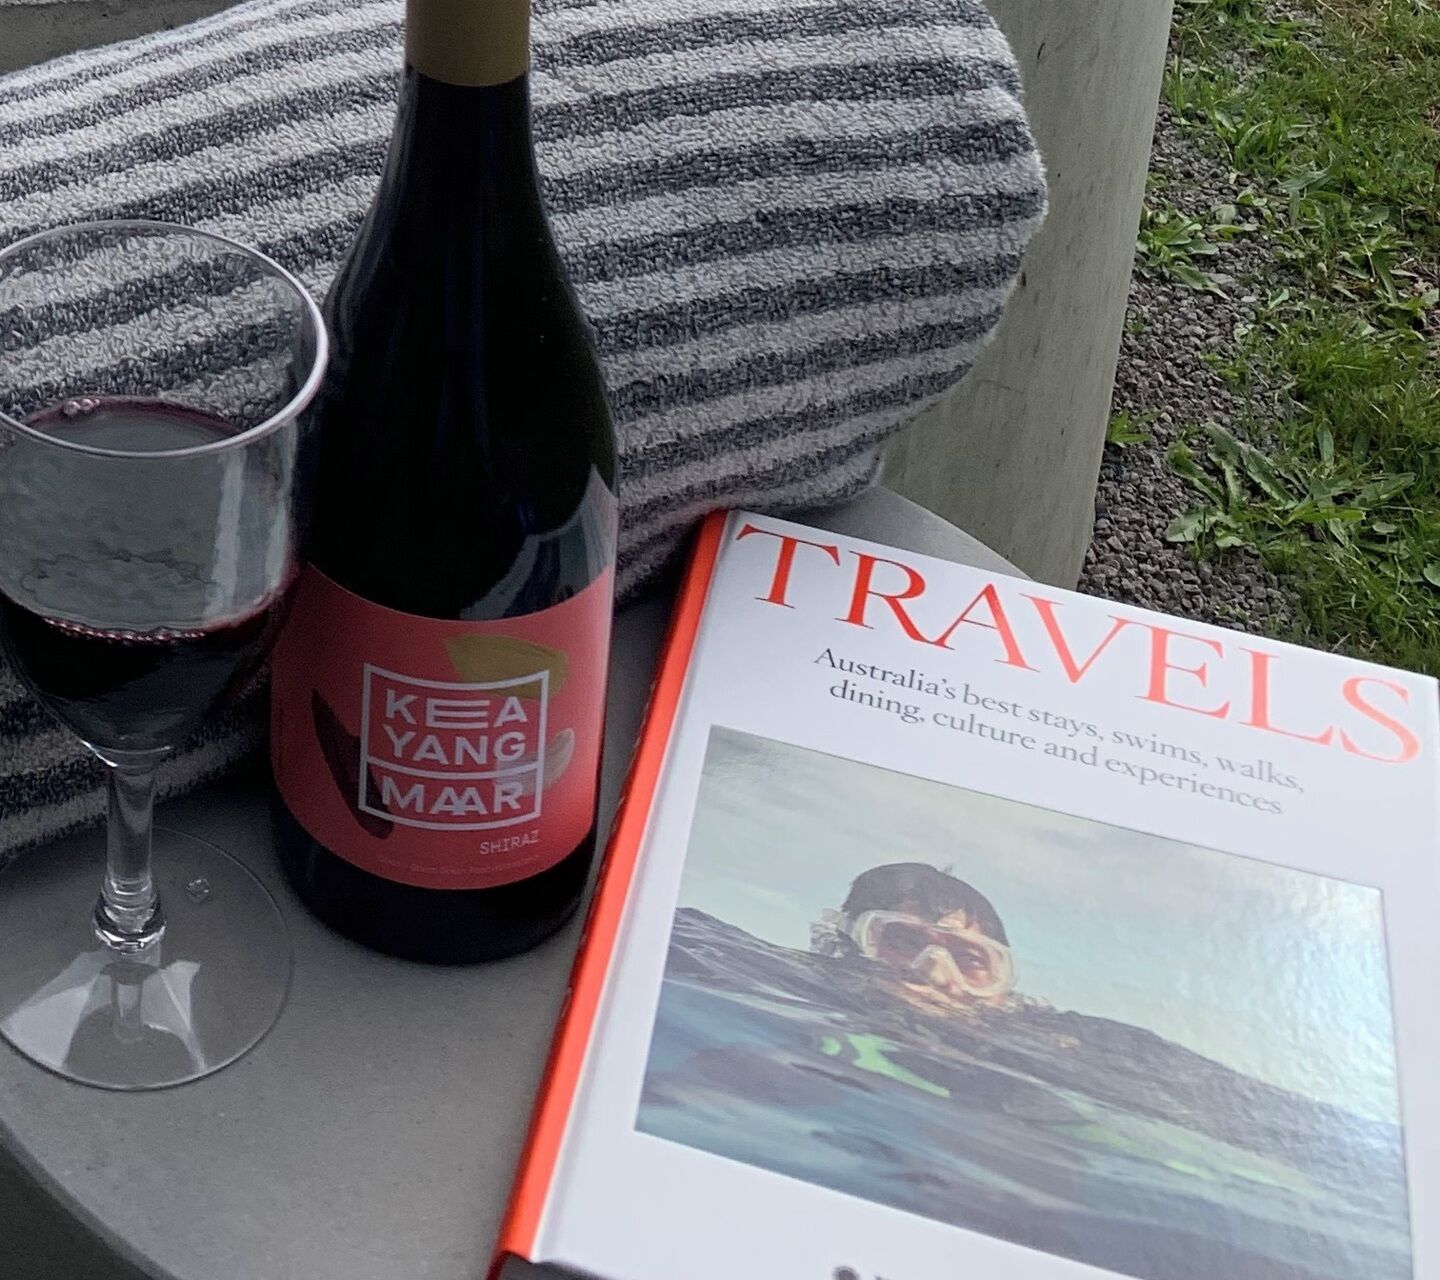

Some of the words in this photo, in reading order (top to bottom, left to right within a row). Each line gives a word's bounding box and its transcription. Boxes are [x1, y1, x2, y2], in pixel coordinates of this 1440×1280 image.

[737, 524, 1420, 764] TRAVELS
[385, 687, 528, 730] KEA
[381, 723, 526, 766] YANG
[829, 679, 925, 724] dining,
[932, 713, 1038, 751] culture
[1043, 741, 1099, 767] and
[1104, 757, 1283, 815] experiences
[962, 683, 1024, 718] best
[1027, 708, 1105, 742] stays,
[1111, 729, 1209, 769] swims,
[1215, 754, 1305, 794] walks,
[381, 775, 524, 816] MAAR
[479, 829, 539, 855] SHIRAZ
